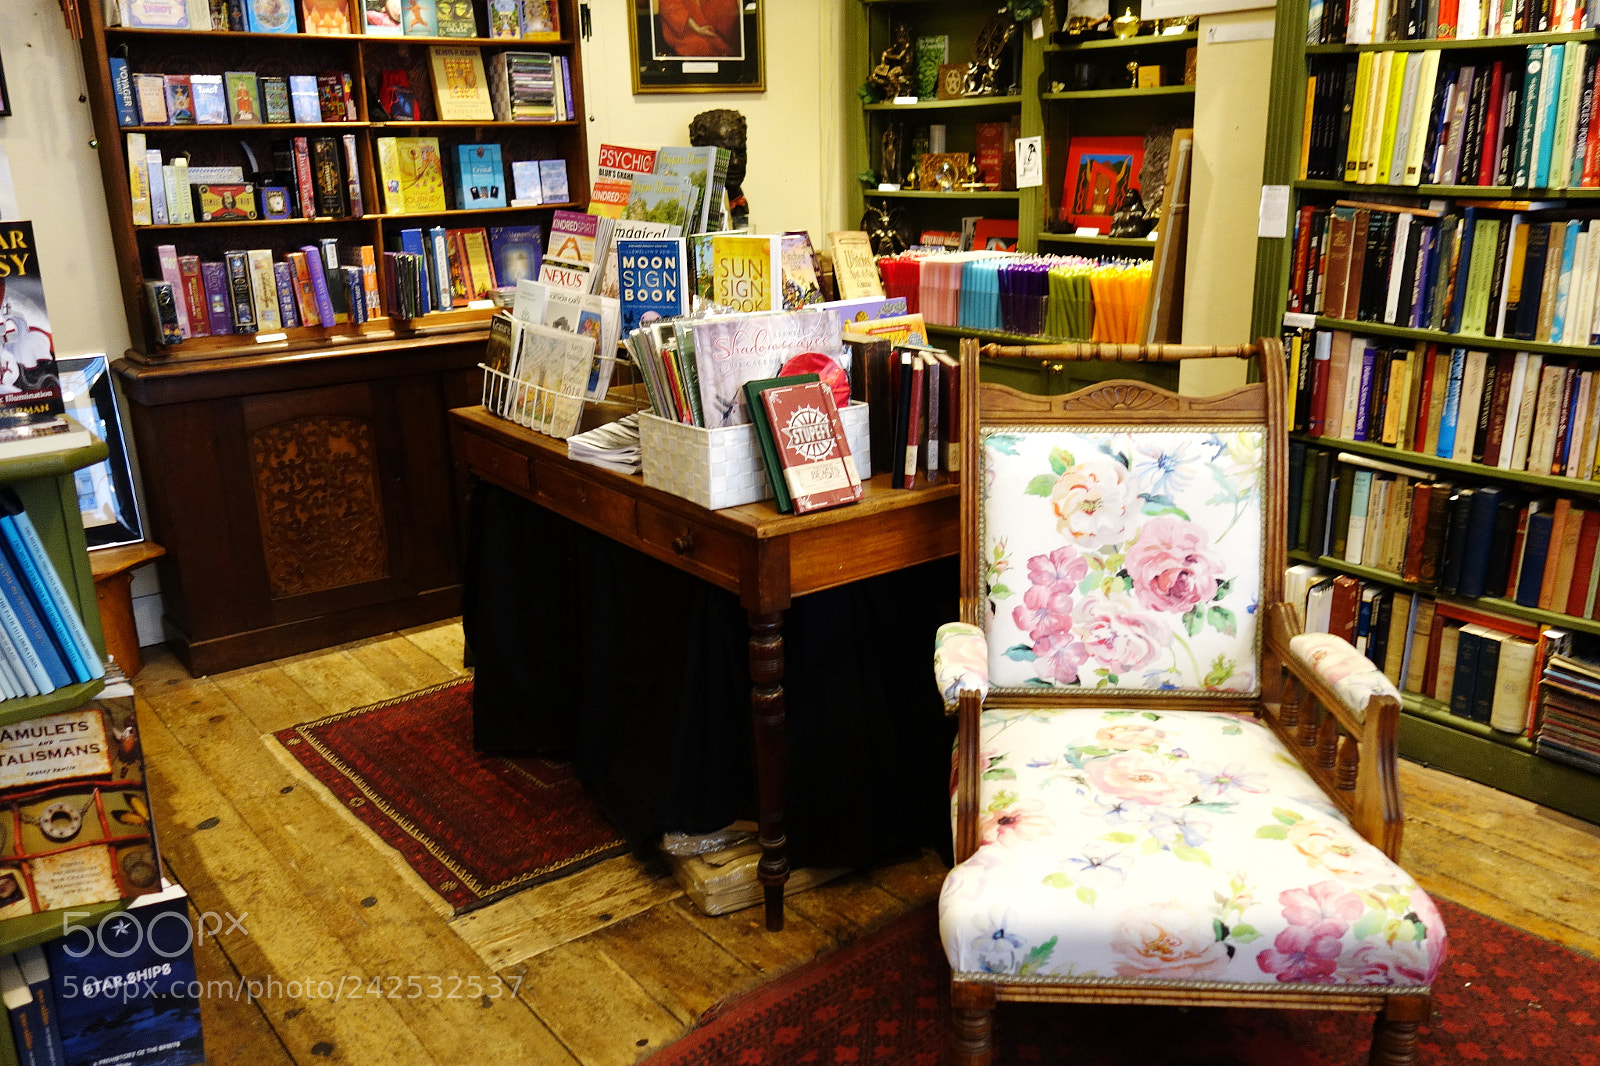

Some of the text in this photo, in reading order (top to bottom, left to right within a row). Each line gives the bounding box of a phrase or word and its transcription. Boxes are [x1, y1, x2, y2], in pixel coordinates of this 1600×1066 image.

[119, 65, 133, 107] VOYAGER
[600, 148, 652, 172] PSYCHIC
[622, 256, 676, 270] MOON
[720, 257, 763, 279] SUN
[544, 267, 583, 289] NEXUS
[622, 270, 677, 288] SIGN
[720, 279, 764, 298] SIGN
[624, 289, 676, 302] BOOK
[713, 329, 828, 360] Shadowscapes
[4, 390, 53, 403] Illumination
[0, 721, 89, 743] AMULETS
[0, 743, 100, 767] TALISMANS
